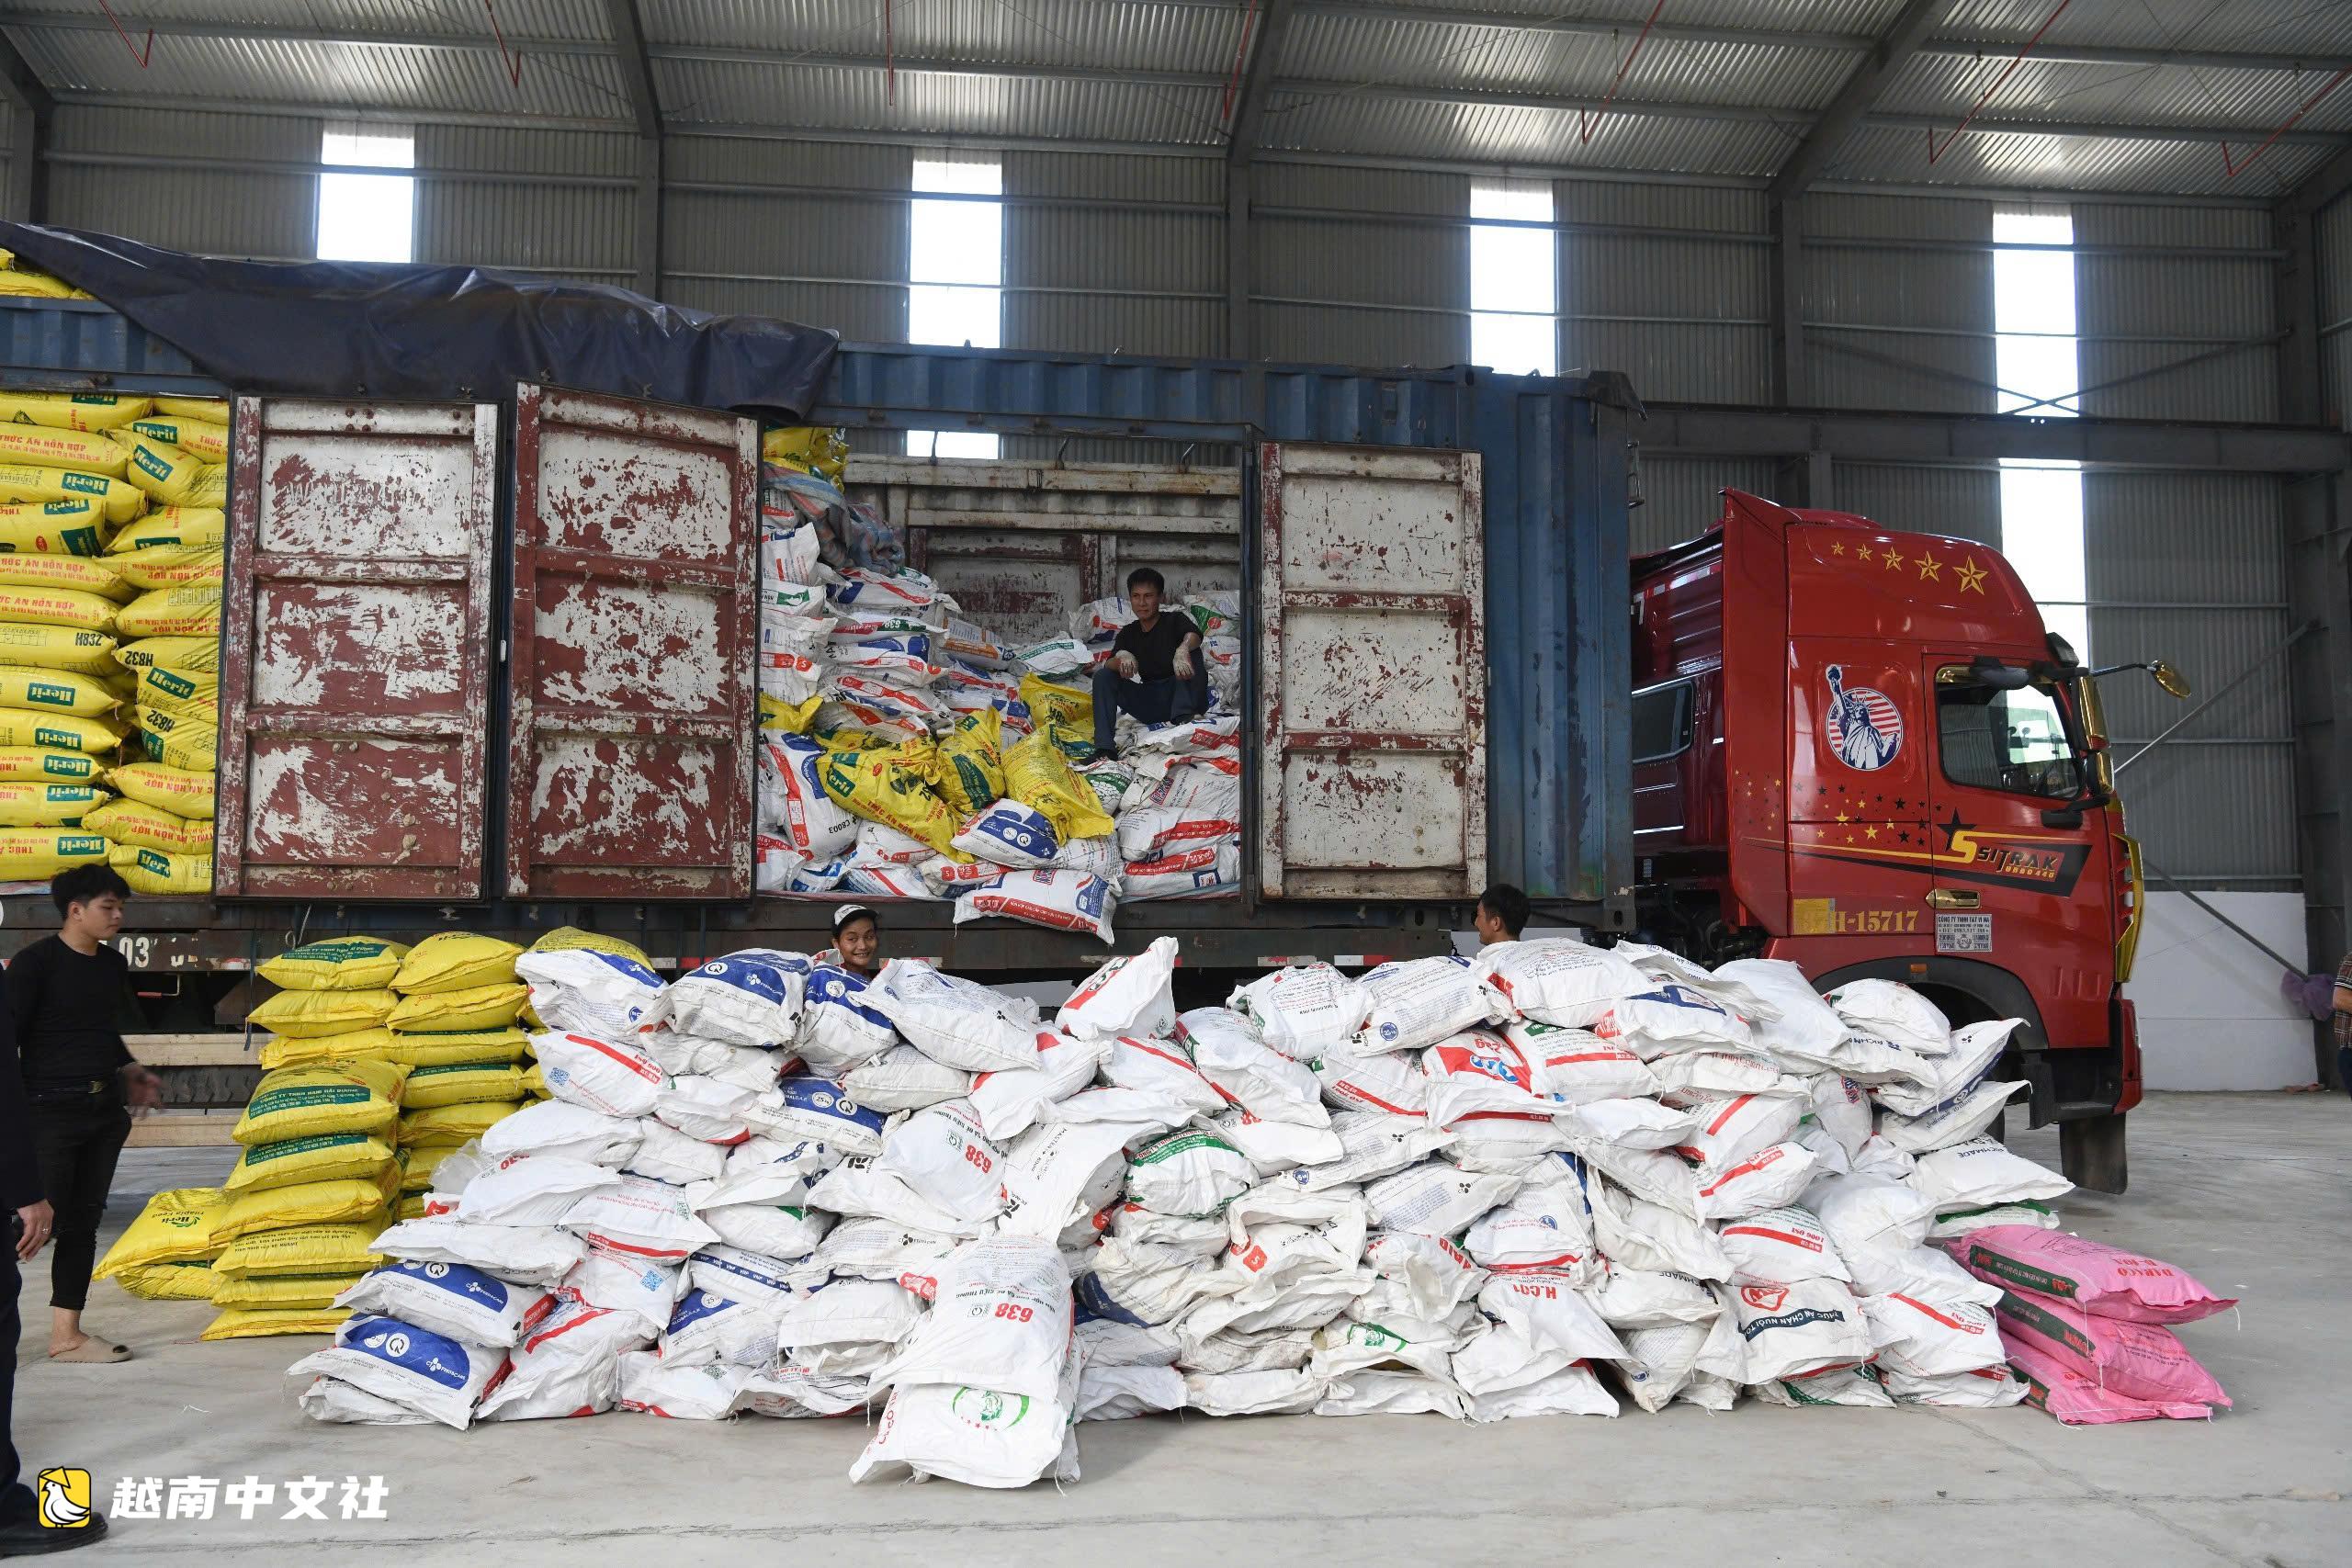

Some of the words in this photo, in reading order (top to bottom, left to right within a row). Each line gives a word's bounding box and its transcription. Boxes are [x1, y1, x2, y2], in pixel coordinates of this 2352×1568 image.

[124, 650, 154, 667] H832
[29, 685, 72, 702] Herit
[146, 709, 175, 732] H832
[38, 730, 78, 748] Herit
[47, 758, 87, 774] Herit
[829, 773, 850, 794] erit
[828, 819, 851, 835] C8003
[60, 839, 102, 852] Herit
[1977, 846, 2058, 873] SITRAK
[1835, 910, 1919, 932] H-15717
[964, 1144, 992, 1174] 638
[995, 1303, 1035, 1324] 638
